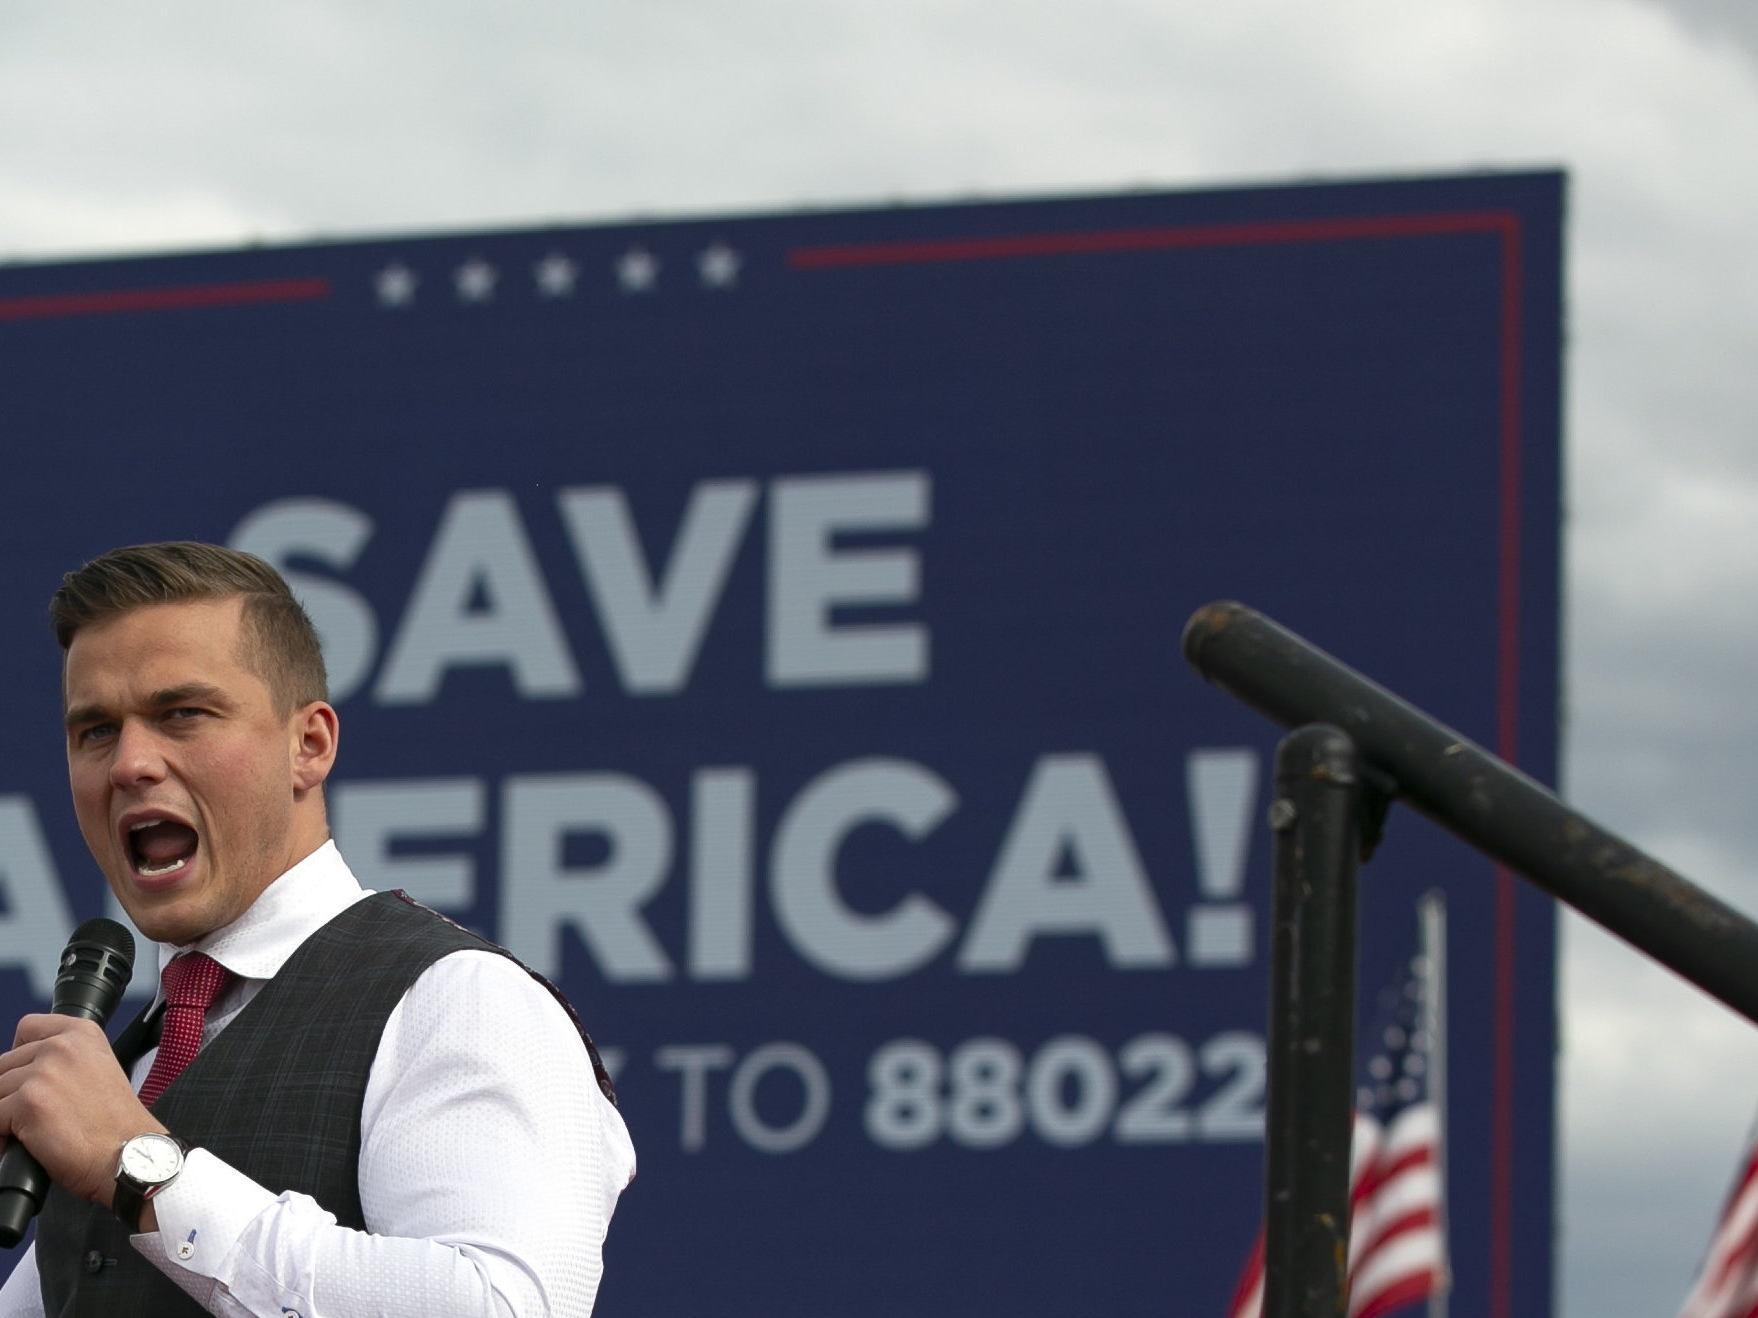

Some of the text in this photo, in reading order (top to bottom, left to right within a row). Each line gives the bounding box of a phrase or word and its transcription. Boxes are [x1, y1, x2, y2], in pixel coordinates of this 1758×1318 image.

[228, 472, 932, 706] SAVE
[653, 1029, 1267, 1156] TO 88022
